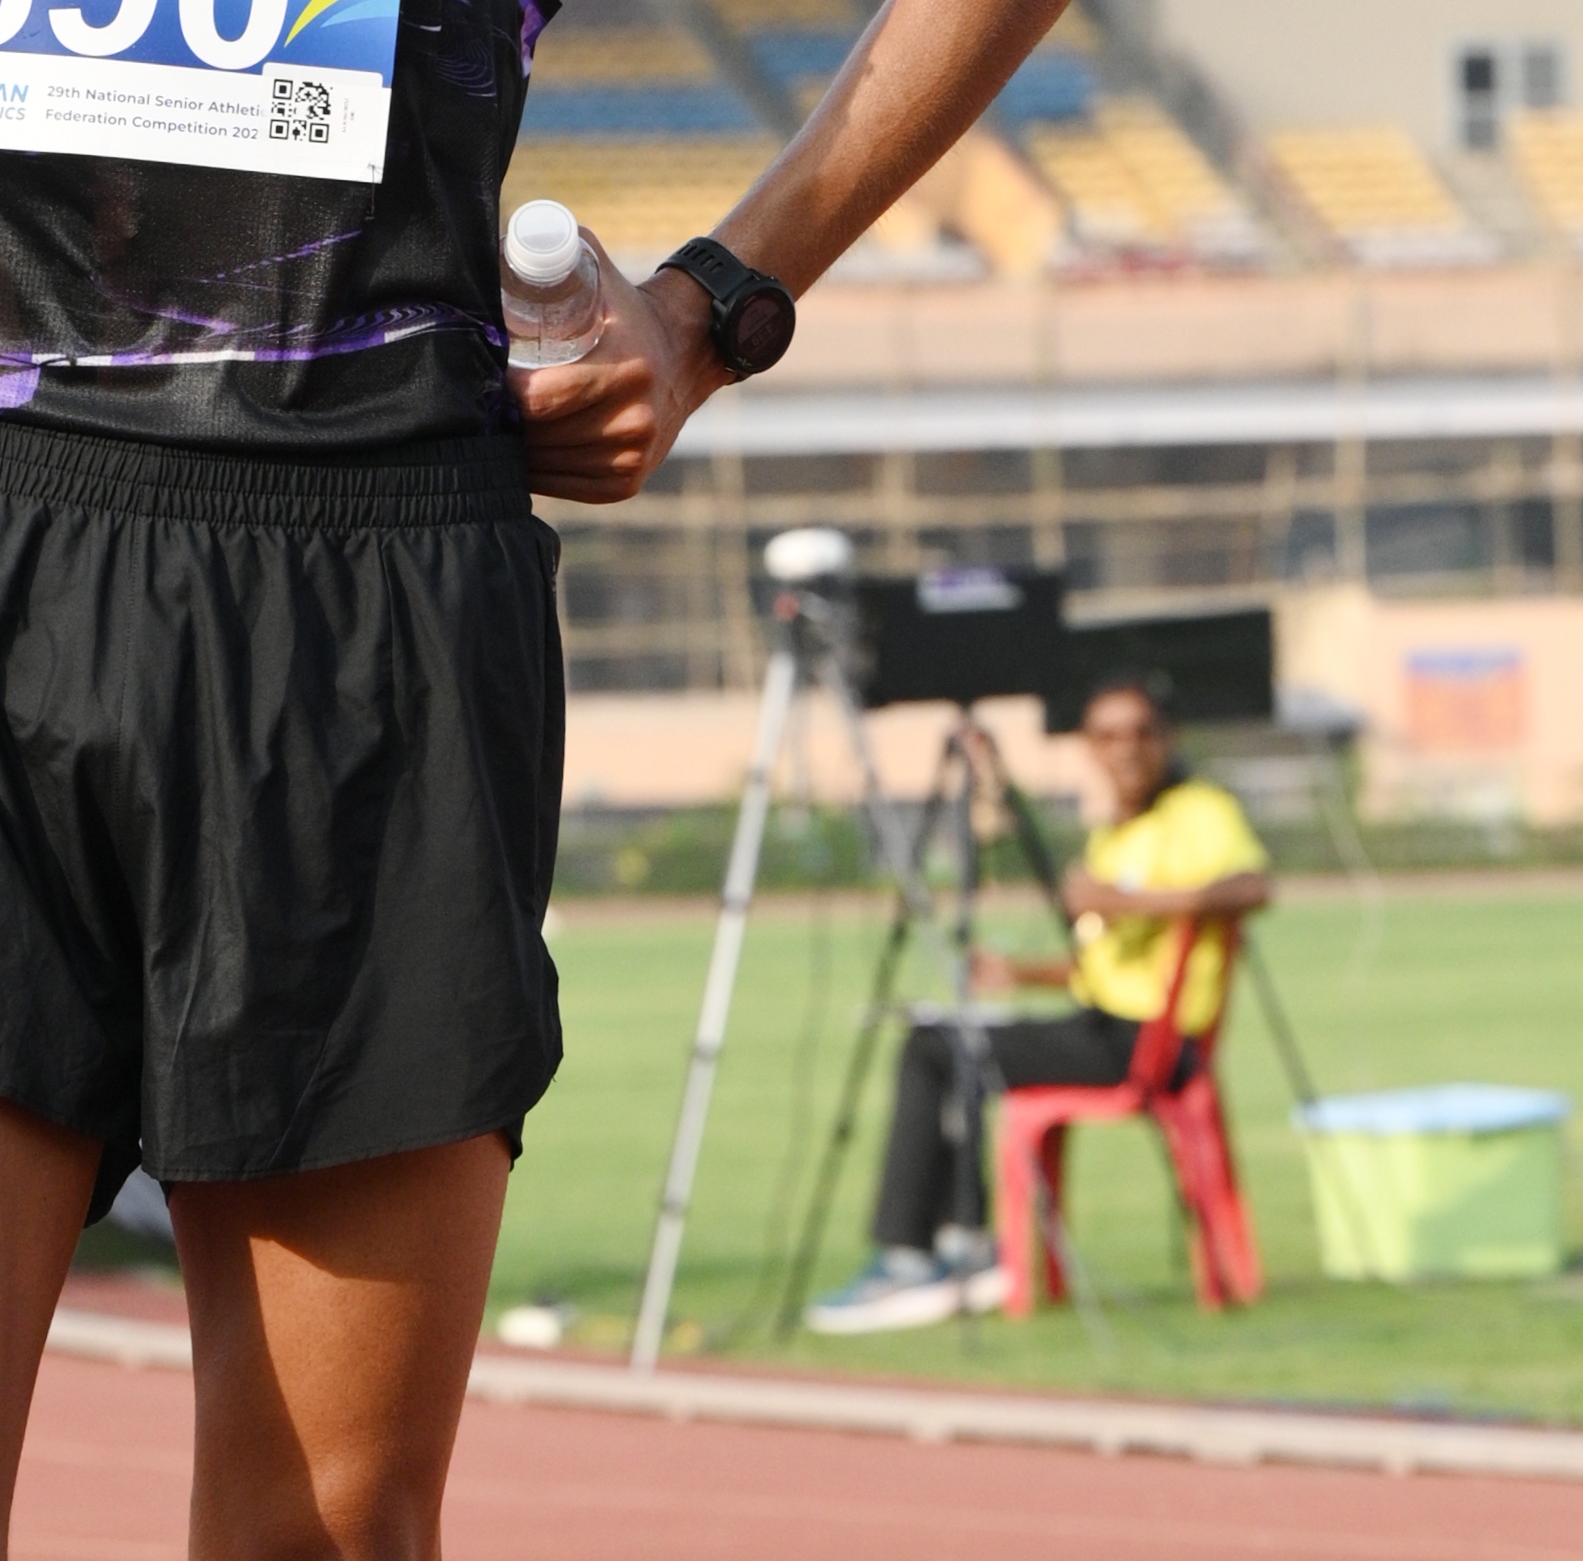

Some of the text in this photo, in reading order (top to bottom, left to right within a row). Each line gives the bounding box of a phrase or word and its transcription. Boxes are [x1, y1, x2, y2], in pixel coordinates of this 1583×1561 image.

[47, 85, 81, 99] 29th
[85, 89, 150, 106] National
[154, 95, 204, 111] Senior
[45, 108, 259, 140] Federation Competition 202
